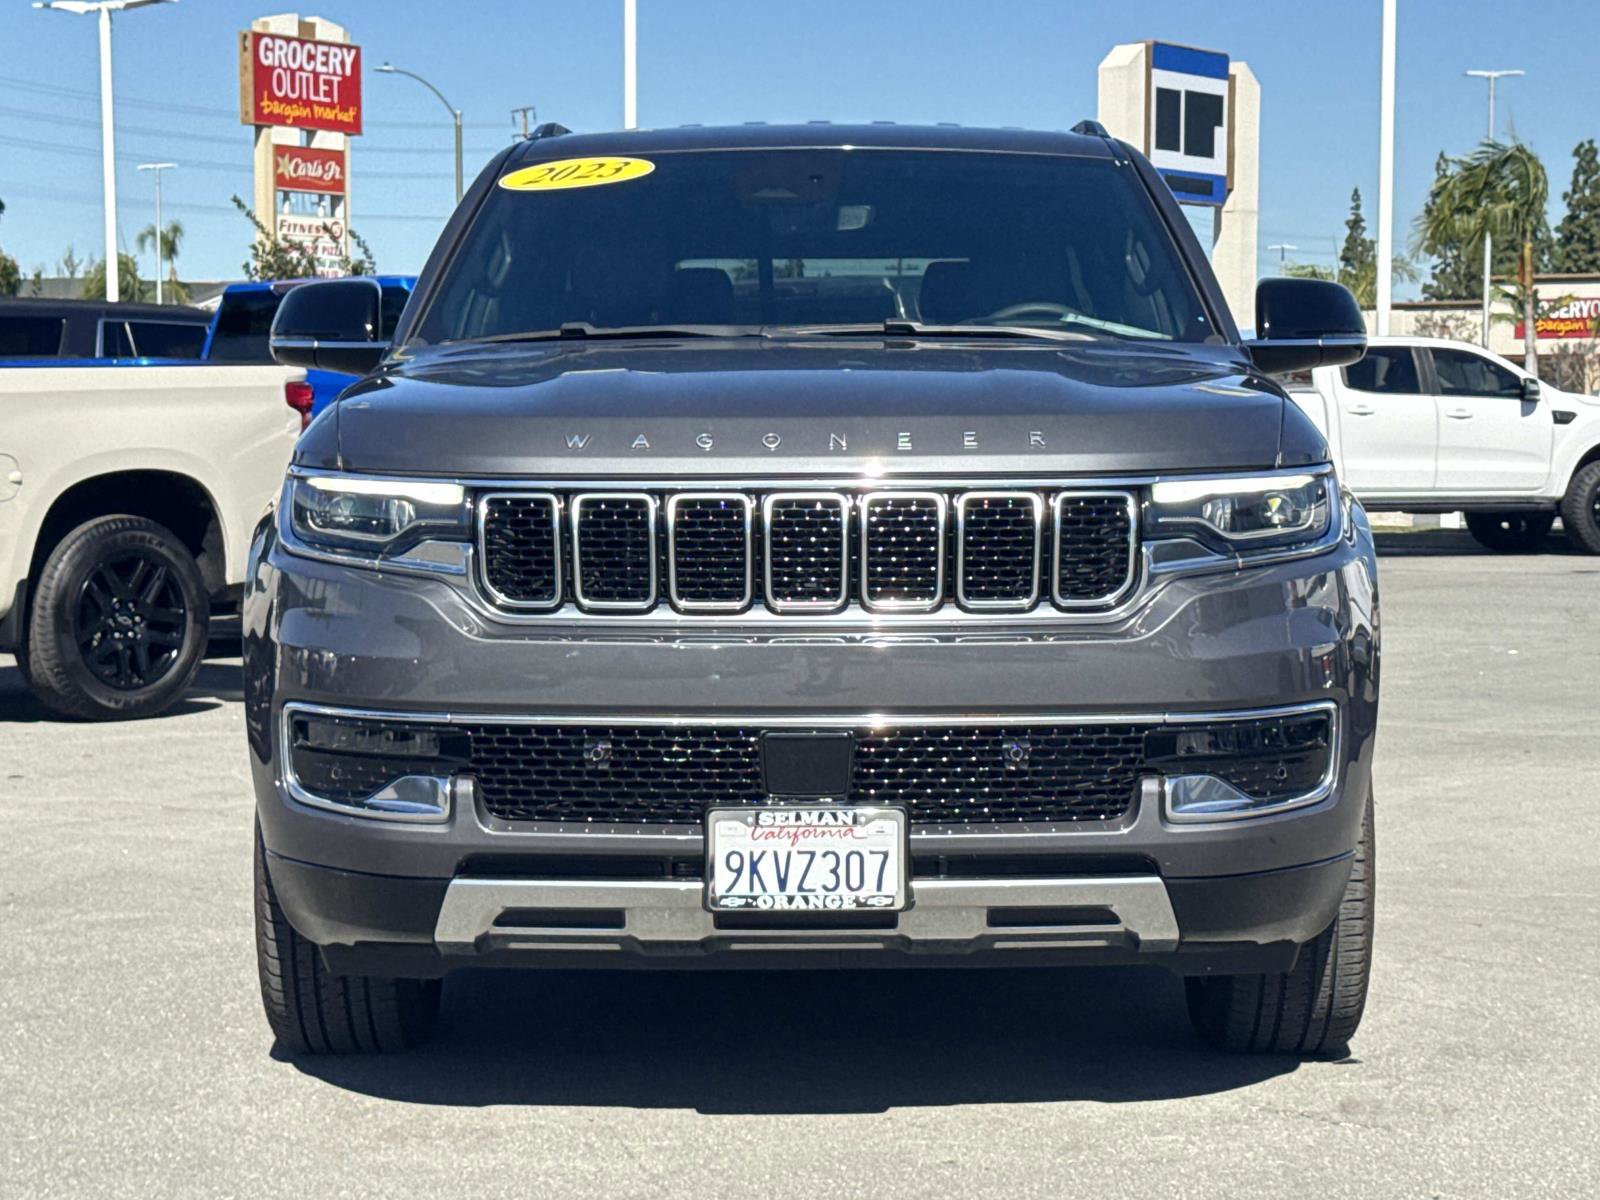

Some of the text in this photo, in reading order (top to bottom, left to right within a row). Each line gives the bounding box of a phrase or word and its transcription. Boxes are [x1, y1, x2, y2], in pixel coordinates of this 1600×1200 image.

[259, 37, 356, 76] GROCERY
[272, 68, 342, 104] OUTLET
[260, 90, 357, 124] bargain market
[522, 161, 631, 186] 2023
[565, 432, 1046, 450] WAGONEER
[758, 811, 855, 826] SELMAN
[751, 825, 867, 847] California
[725, 850, 889, 893] 9KVZ307
[757, 895, 857, 910] ORANGE
